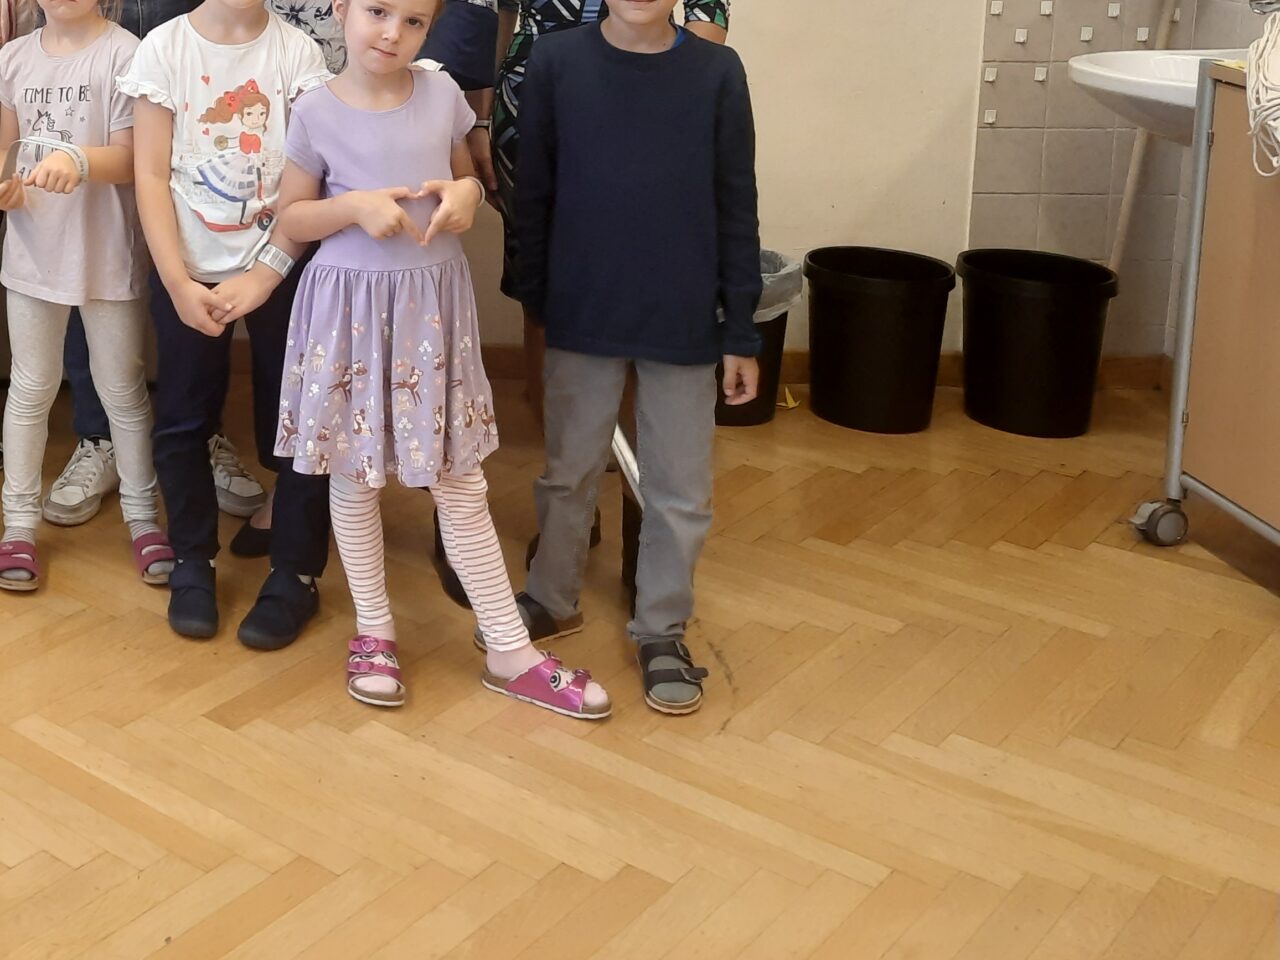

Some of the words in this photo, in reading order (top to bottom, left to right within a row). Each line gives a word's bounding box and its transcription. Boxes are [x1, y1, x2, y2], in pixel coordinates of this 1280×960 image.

[23, 87, 53, 104] TIME
[59, 86, 74, 103] TO
[78, 84, 91, 102] BE
